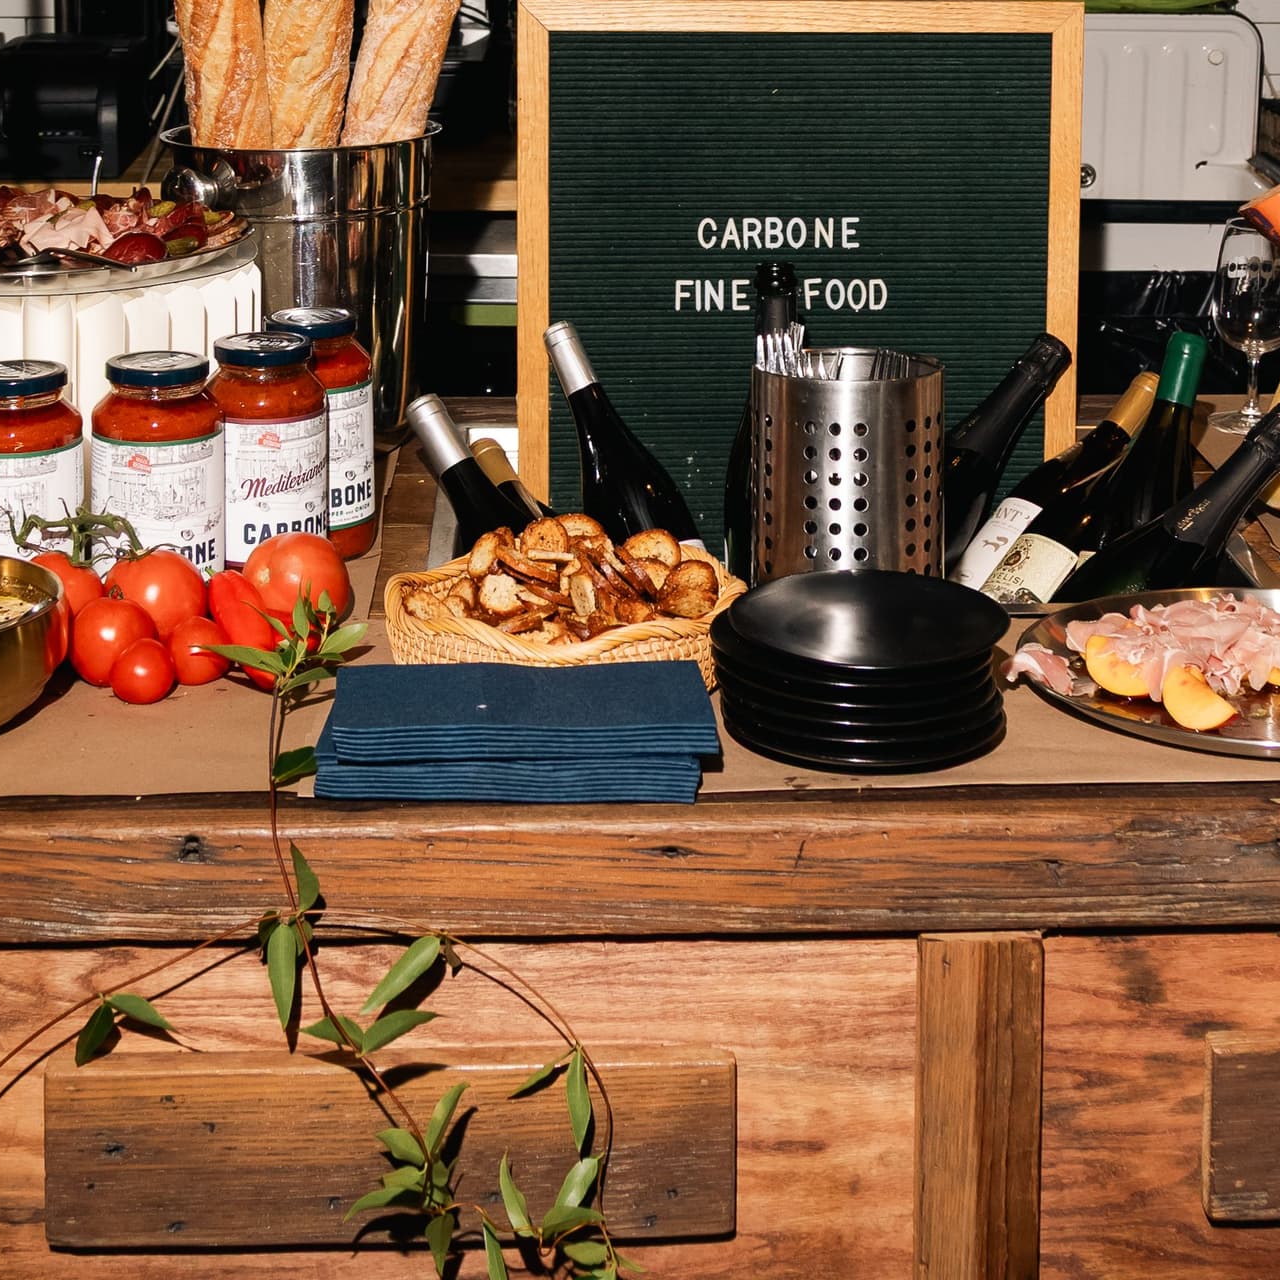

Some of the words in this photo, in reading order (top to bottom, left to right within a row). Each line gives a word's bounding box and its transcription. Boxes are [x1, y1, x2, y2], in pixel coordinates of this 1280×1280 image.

[697, 217, 860, 250] CARBONE
[674, 279, 751, 312] FINE
[803, 278, 888, 312] FOOD
[330, 478, 372, 508] BONE
